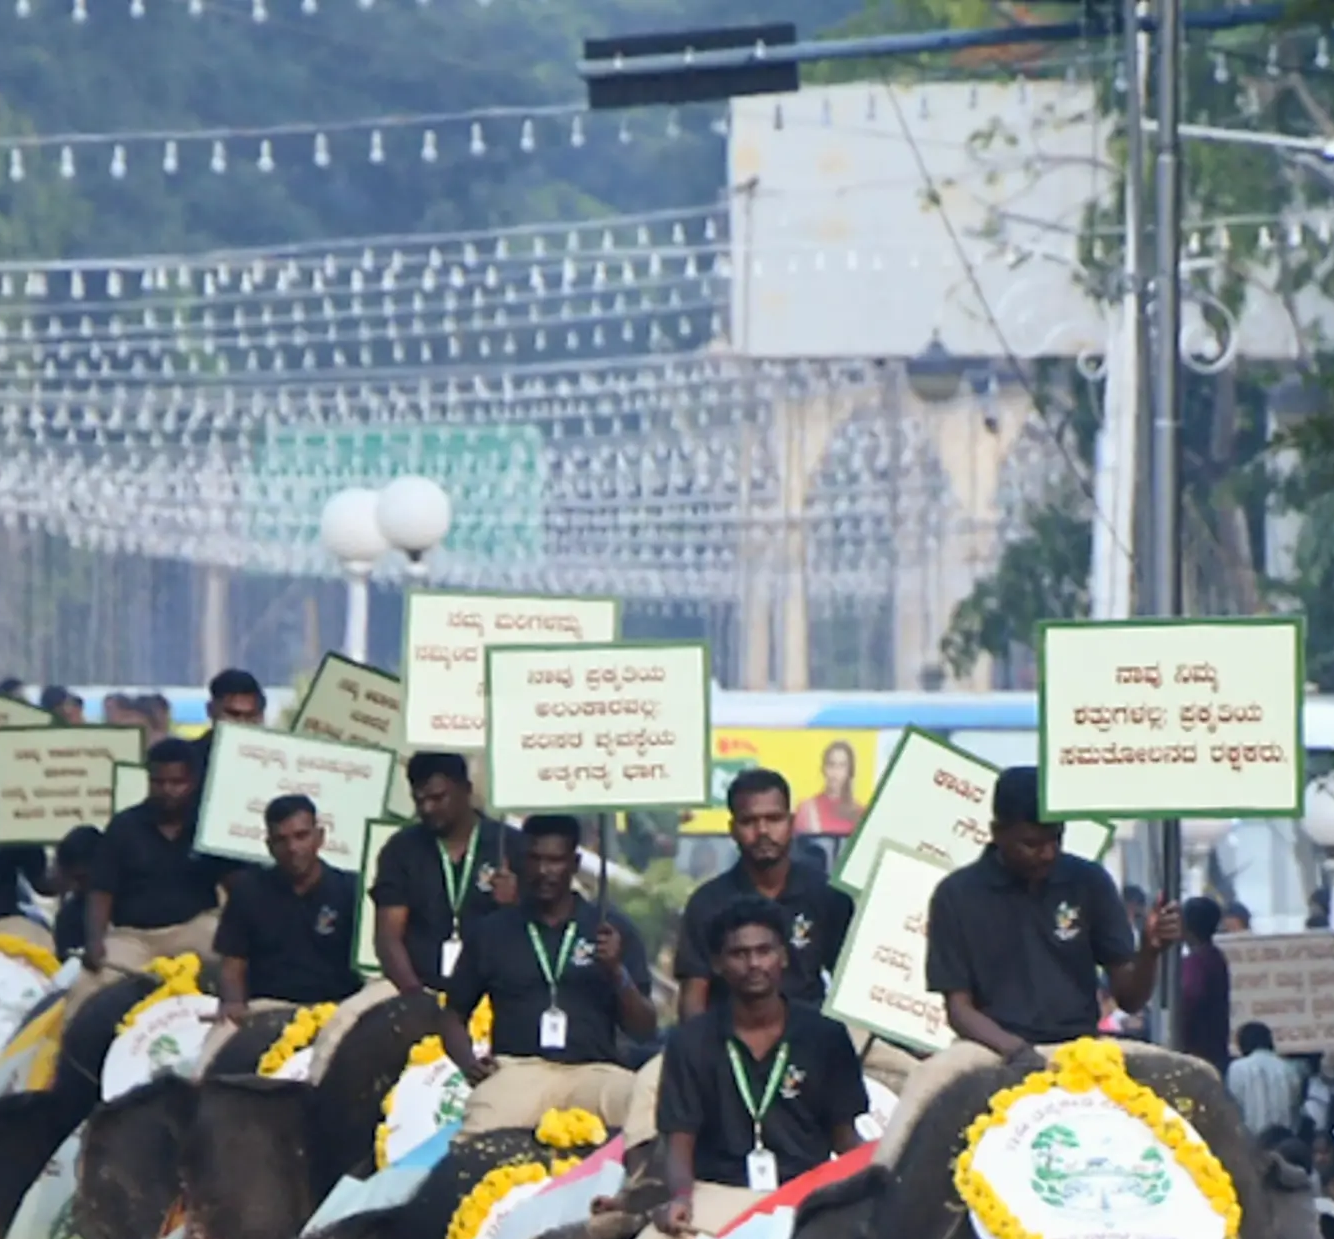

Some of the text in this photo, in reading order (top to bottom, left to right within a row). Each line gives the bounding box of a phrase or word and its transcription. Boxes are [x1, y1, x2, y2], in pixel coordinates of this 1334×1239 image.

[527, 665, 666, 691] ನಾವು ಪ್ರಕೃತಿಯ
[1115, 662, 1220, 693] ನಾವು ನಿಮ್ಮ
[1179, 702, 1263, 733] ಪ್ರಕೃತಿಯ
[1060, 743, 1197, 765] ಸಮತೋಲನದ
